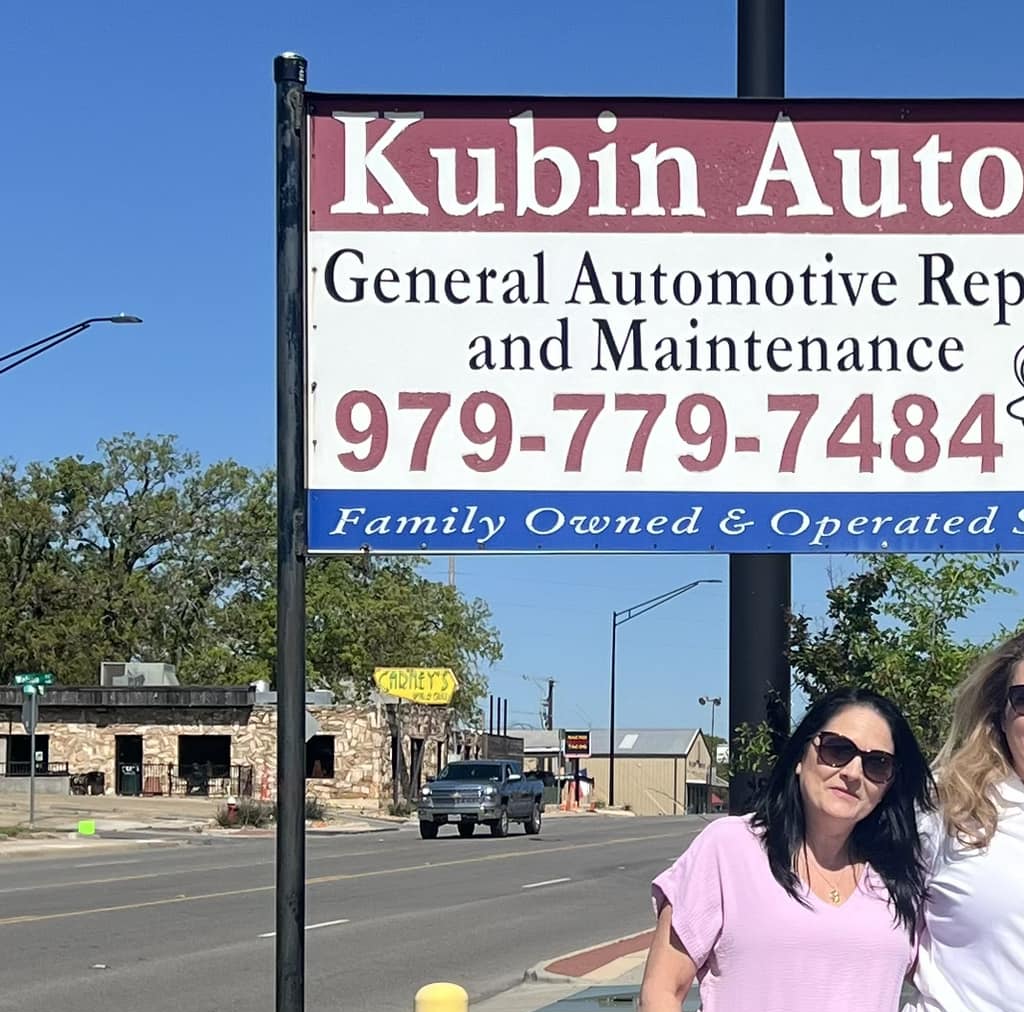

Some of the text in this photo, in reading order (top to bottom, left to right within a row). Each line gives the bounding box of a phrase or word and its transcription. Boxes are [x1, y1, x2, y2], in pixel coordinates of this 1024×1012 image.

[330, 110, 706, 218] Kubin
[324, 248, 549, 304] General
[566, 250, 898, 306] Automotive
[467, 317, 966, 374] and Maintenance
[334, 390, 1004, 475] 979-779-7484
[328, 505, 506, 544] Family
[524, 505, 703, 536] Owned
[719, 508, 755, 536] &
[769, 505, 1000, 546] Operated
